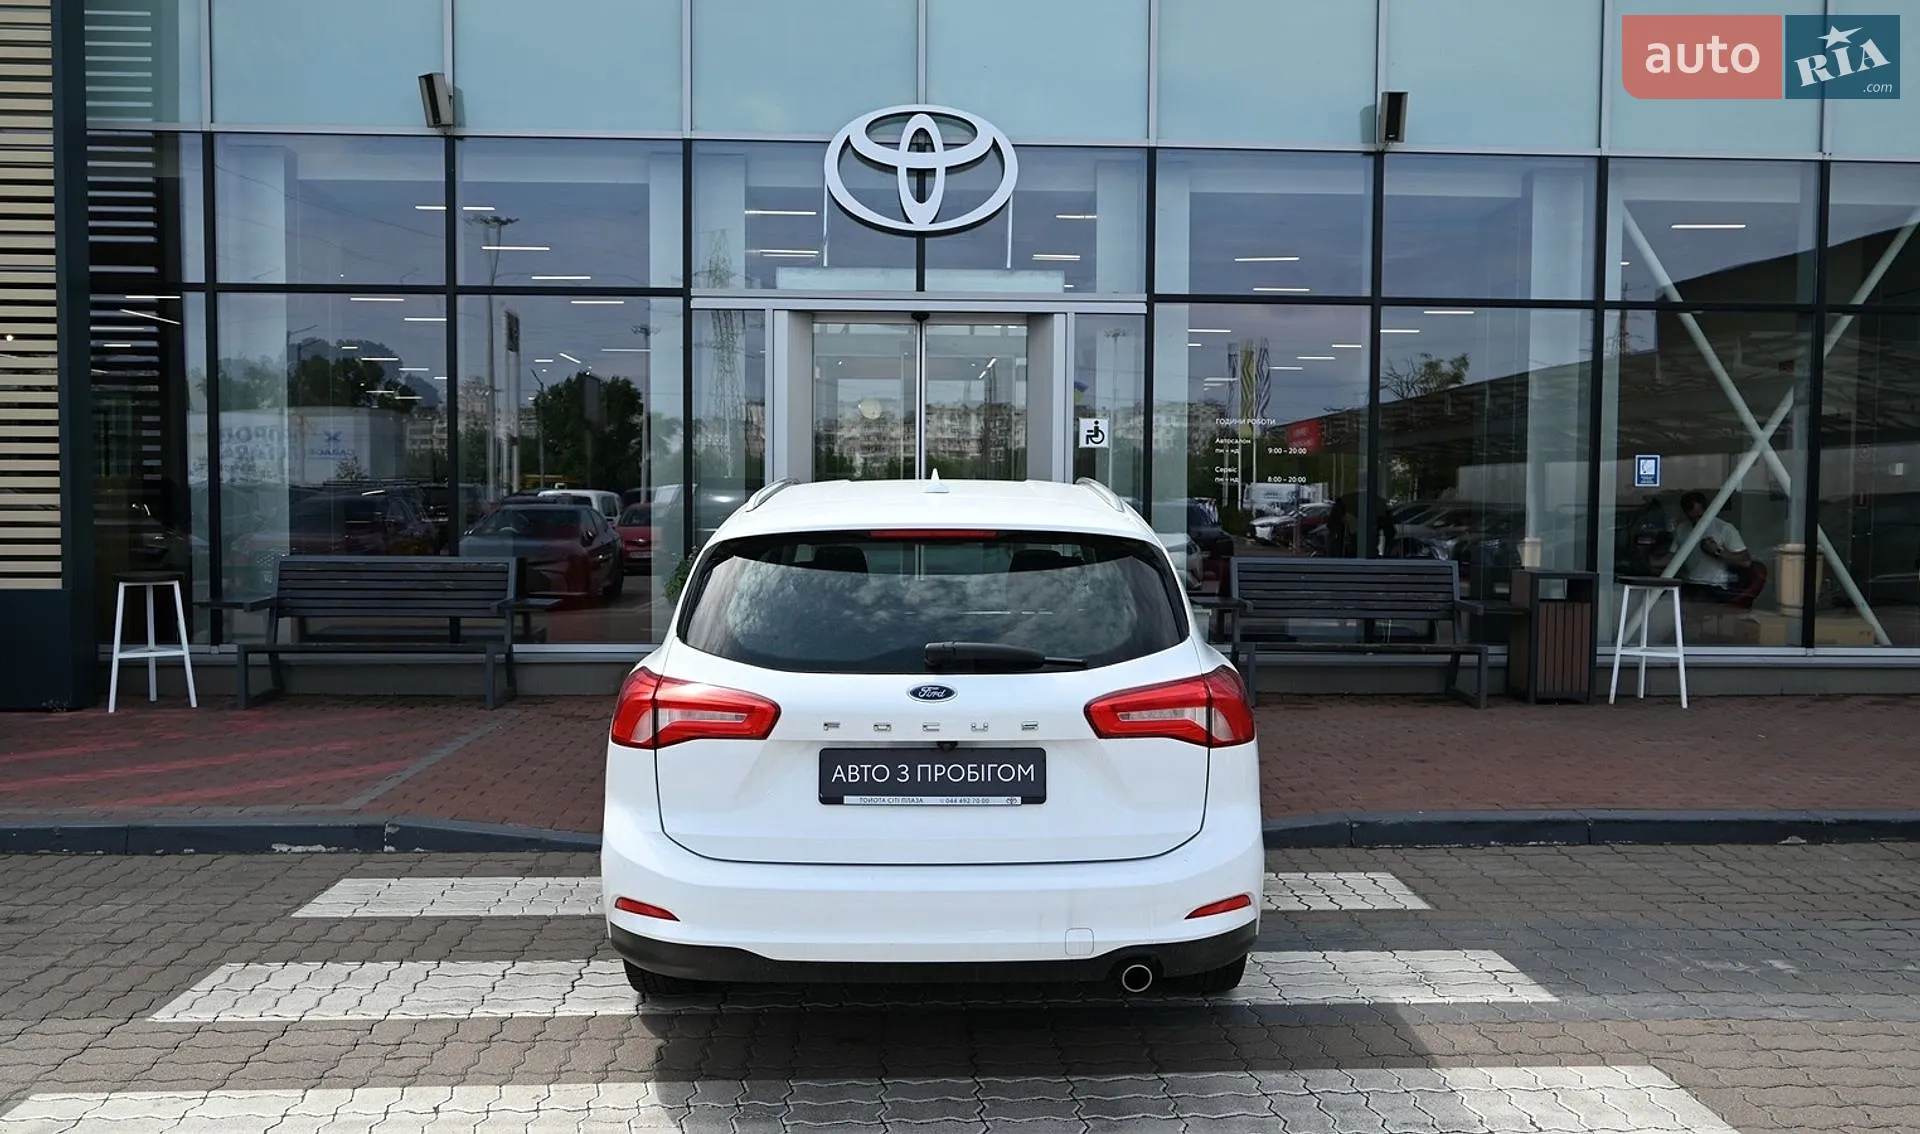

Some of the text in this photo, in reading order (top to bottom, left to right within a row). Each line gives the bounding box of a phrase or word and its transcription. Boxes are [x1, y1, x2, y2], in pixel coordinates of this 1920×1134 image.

[918, 686, 947, 698] Ford
[823, 721, 1039, 732] FOCUS
[831, 764, 890, 783] АВТО
[917, 764, 1035, 783] ПРОБІГОМ
